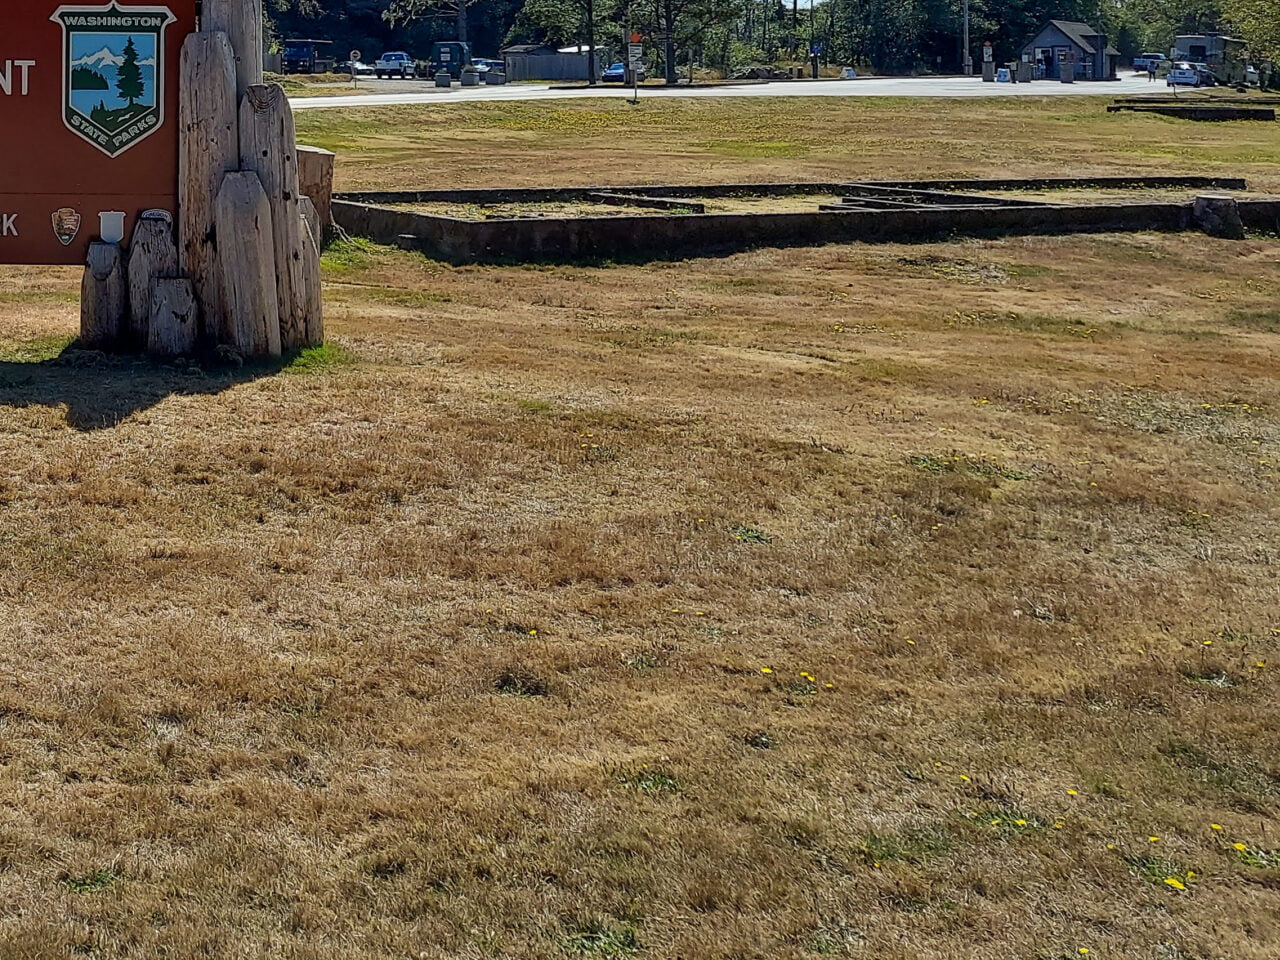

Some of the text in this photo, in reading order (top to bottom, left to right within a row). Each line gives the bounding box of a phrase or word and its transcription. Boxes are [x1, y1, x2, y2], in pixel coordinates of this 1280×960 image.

[64, 16, 162, 27] WASHINGTON
[70, 114, 157, 146] STATE PARKS
